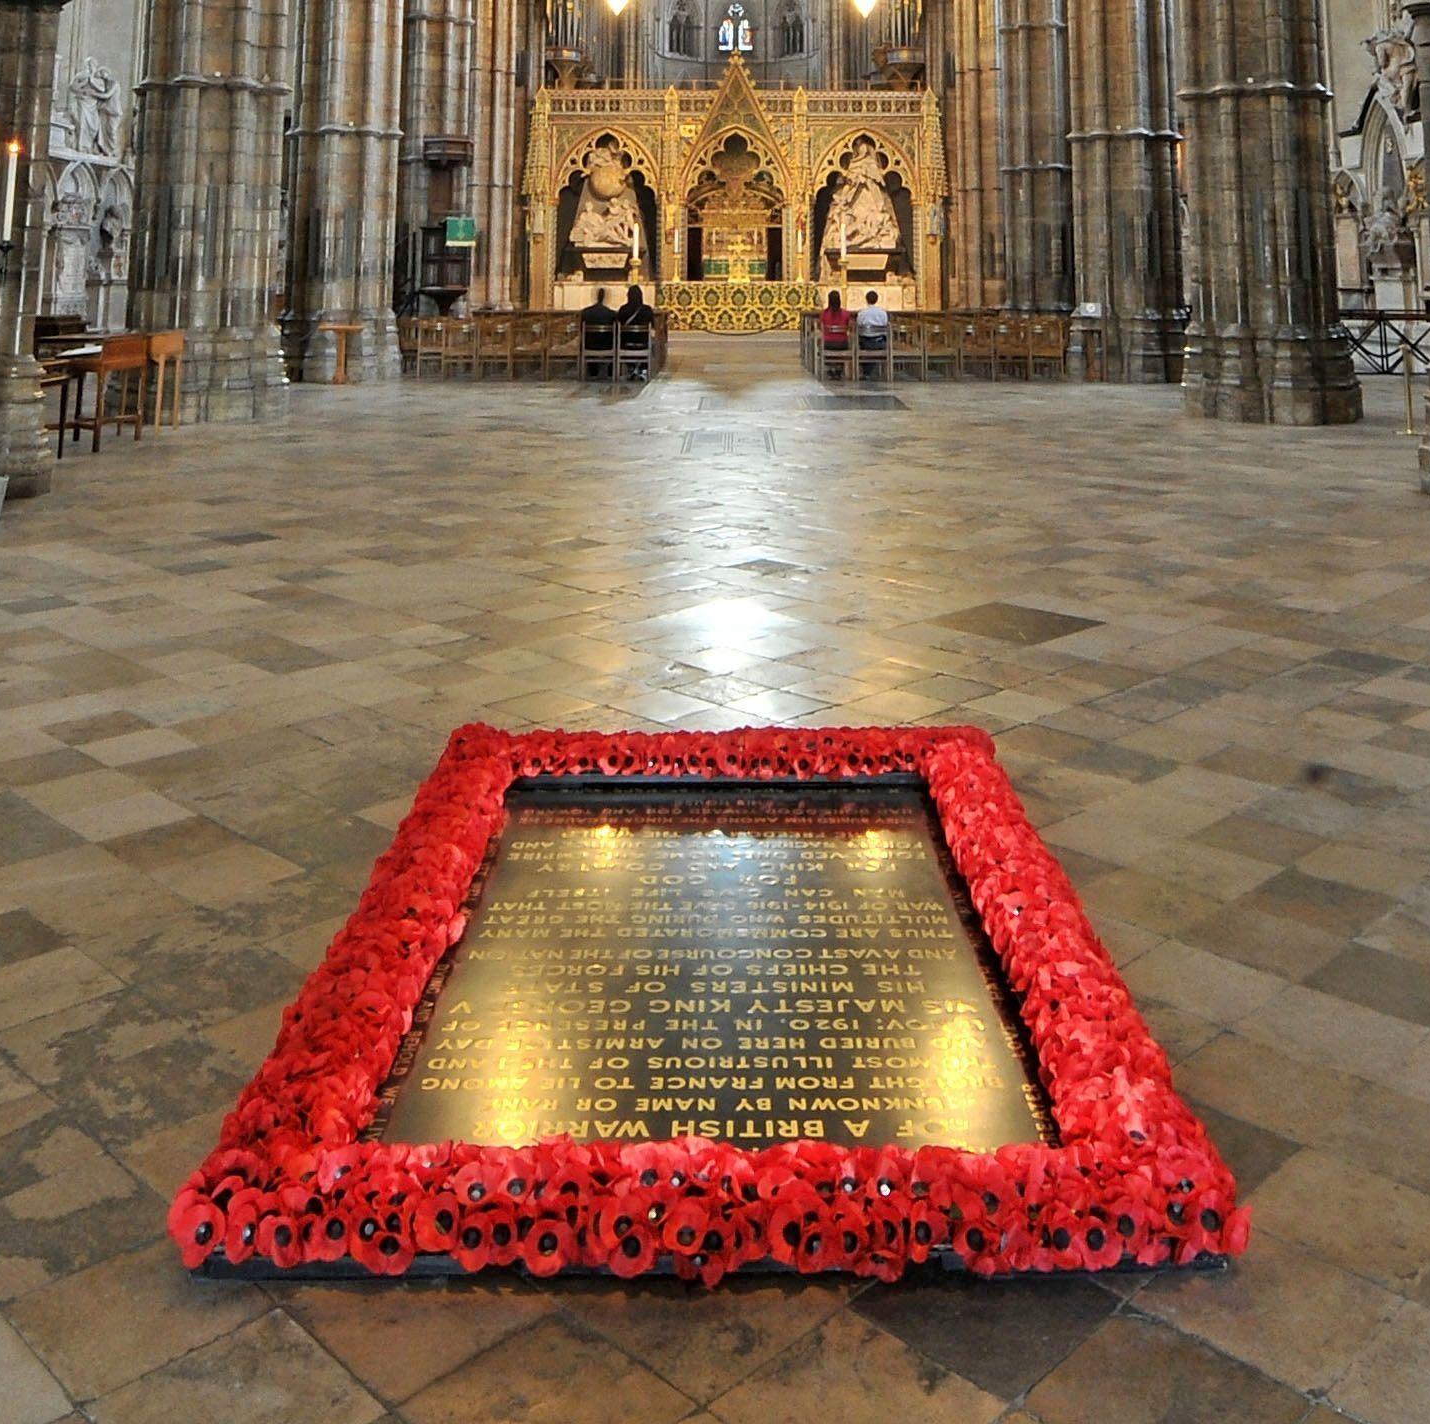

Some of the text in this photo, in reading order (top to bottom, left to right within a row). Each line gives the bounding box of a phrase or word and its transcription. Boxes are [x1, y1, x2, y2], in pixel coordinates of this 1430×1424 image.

[510, 840, 554, 849] AND
[756, 861, 825, 872] KING
[637, 874, 707, 885] GOD
[783, 888, 834, 897] CAN
[486, 901, 546, 911] THAT
[858, 901, 889, 911] OF
[894, 901, 945, 911] WAR
[480, 914, 565, 924] GREAT
[629, 914, 719, 924] DURING
[796, 914, 948, 924] MULTITUDES
[477, 928, 551, 938] MANY
[559, 928, 607, 938] THE
[834, 928, 881, 938] ARE
[887, 928, 954, 938] THUS
[467, 947, 565, 960] NATION
[569, 947, 613, 960] THE
[623, 947, 653, 960] OF
[657, 947, 814, 960] CONCOURSE
[906, 947, 957, 960] AND
[507, 963, 922, 976] THE CHIEFS OF HIS FORCES
[502, 981, 925, 993] HIS MINISTERS OF STATE
[448, 999, 472, 1013] V
[647, 999, 732, 1013] KING
[746, 999, 905, 1013] MAJESTY
[440, 1018, 481, 1031] OF
[497, 1018, 647, 1031] PRESENCE
[665, 1018, 719, 1031] THE
[733, 1018, 762, 1031] IN
[435, 1037, 494, 1050] DAY
[504, 1037, 665, 1050] ARMISTICE
[680, 1037, 723, 1050] ON
[737, 1037, 806, 1050] HERE
[818, 1037, 916, 1050] BURIED
[588, 1056, 631, 1069] OF
[646, 1056, 833, 1069] ILLUSTRIOUS
[851, 1056, 932, 1069] MOST
[421, 1077, 531, 1090] AMONG
[538, 1077, 581, 1090] LIE
[592, 1077, 635, 1090] TO
[649, 1077, 764, 1090] FRANCE
[775, 1077, 854, 1090] FROM
[575, 1097, 618, 1111] OR
[634, 1097, 717, 1111] NAME
[734, 1097, 772, 1111] BY
[788, 1097, 946, 1111] UNKNOWN
[471, 1119, 949, 1139] OF A BRITISH WARRIOR
